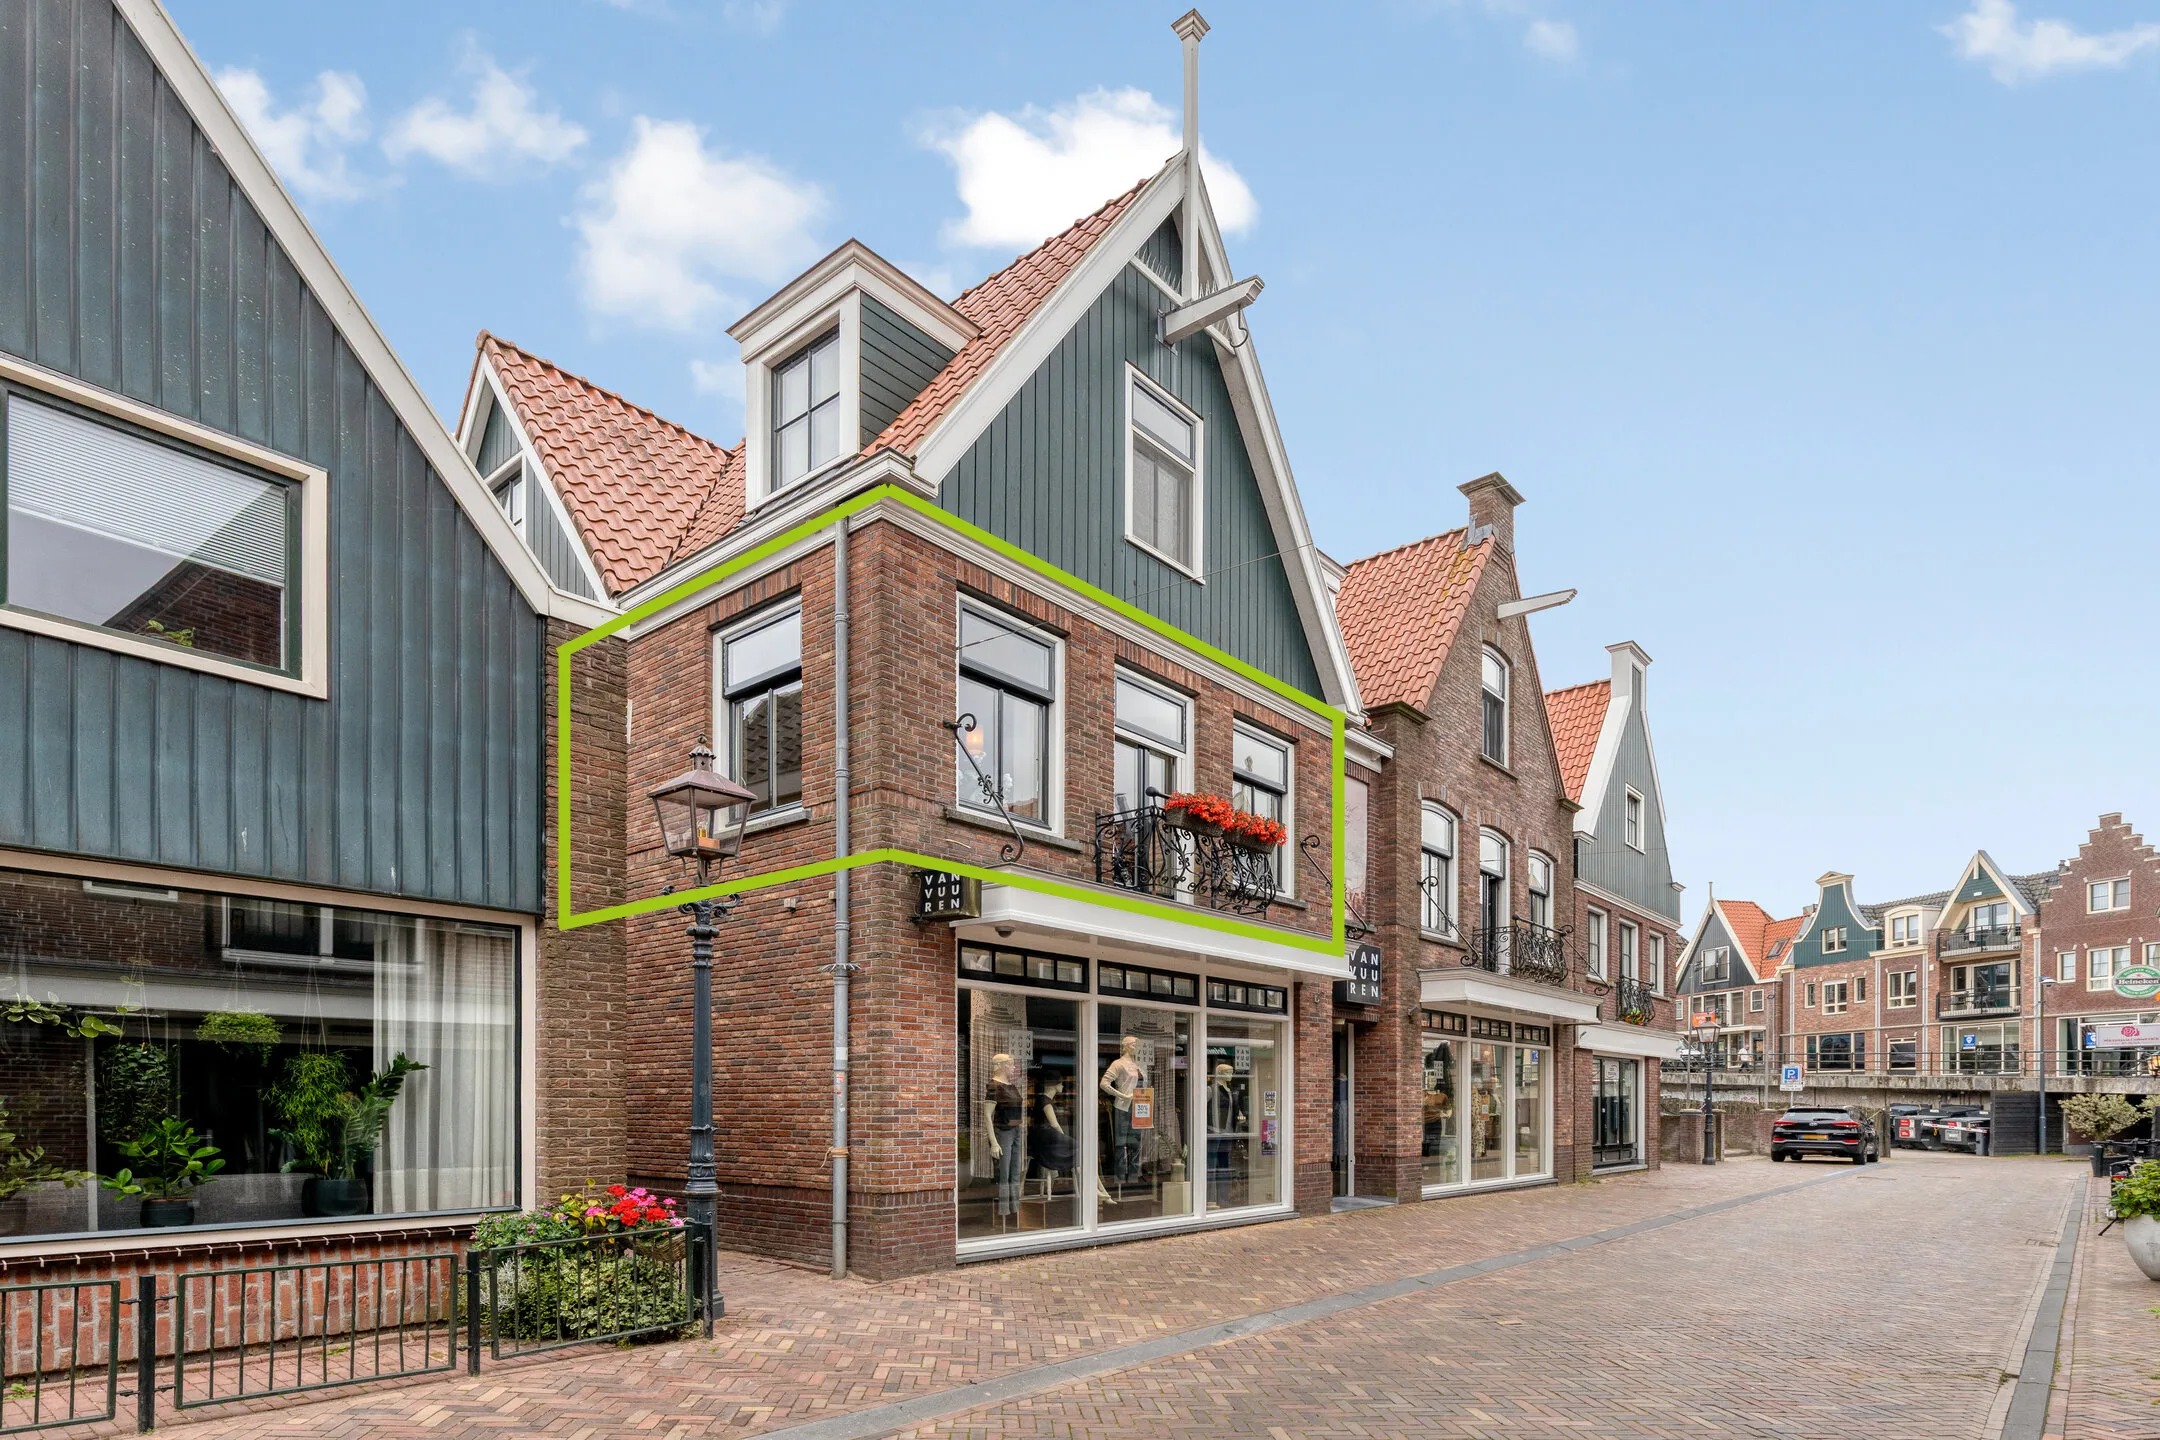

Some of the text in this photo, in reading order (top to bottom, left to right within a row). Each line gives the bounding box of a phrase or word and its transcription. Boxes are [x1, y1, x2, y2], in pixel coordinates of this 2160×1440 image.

[925, 873, 960, 885] VAN
[924, 884, 960, 899] VUU
[924, 898, 960, 912] REN
[1350, 950, 1379, 966] VAN
[1350, 982, 1379, 998] REN
